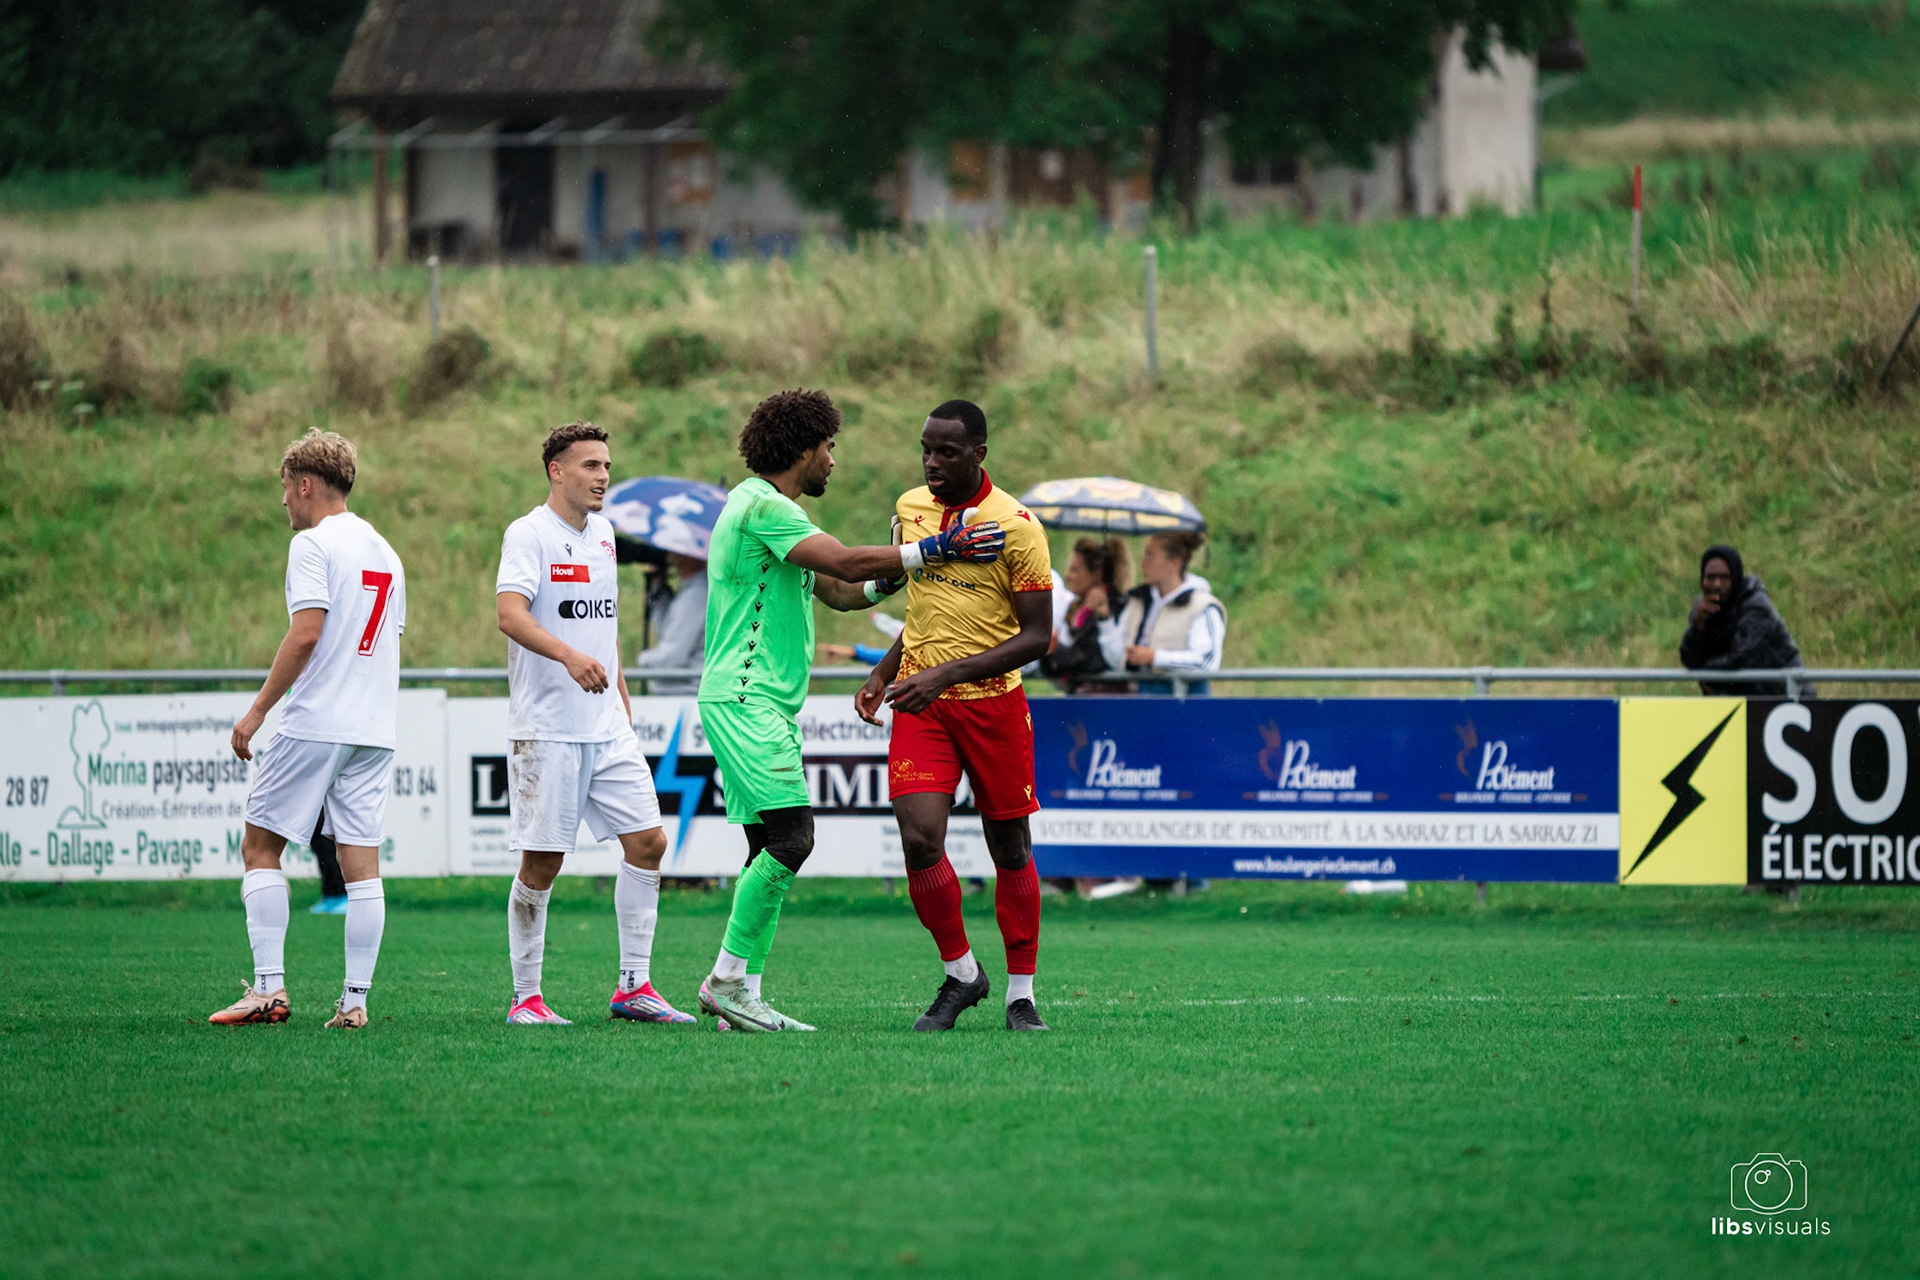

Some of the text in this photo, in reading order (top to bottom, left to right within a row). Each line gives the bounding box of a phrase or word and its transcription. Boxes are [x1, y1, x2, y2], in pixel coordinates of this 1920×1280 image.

[552, 566, 574, 576] Hoval
[358, 570, 394, 656] 7
[88, 752, 147, 786] Morina
[153, 749, 248, 794] paysagiste
[417, 765, 437, 796] 64
[1762, 702, 1920, 824] SO
[6, 776, 48, 806] 28 87
[1101, 820, 1208, 840] BOULANGER
[1356, 823, 1377, 841] LA
[1383, 823, 1450, 842] SARRAZ
[1455, 824, 1477, 842] ET
[1483, 824, 1503, 843] LA
[1509, 825, 1577, 843] SARRAZ
[1582, 825, 1599, 844] ZI
[47, 831, 114, 873] Dallage
[136, 830, 203, 873] Pavage
